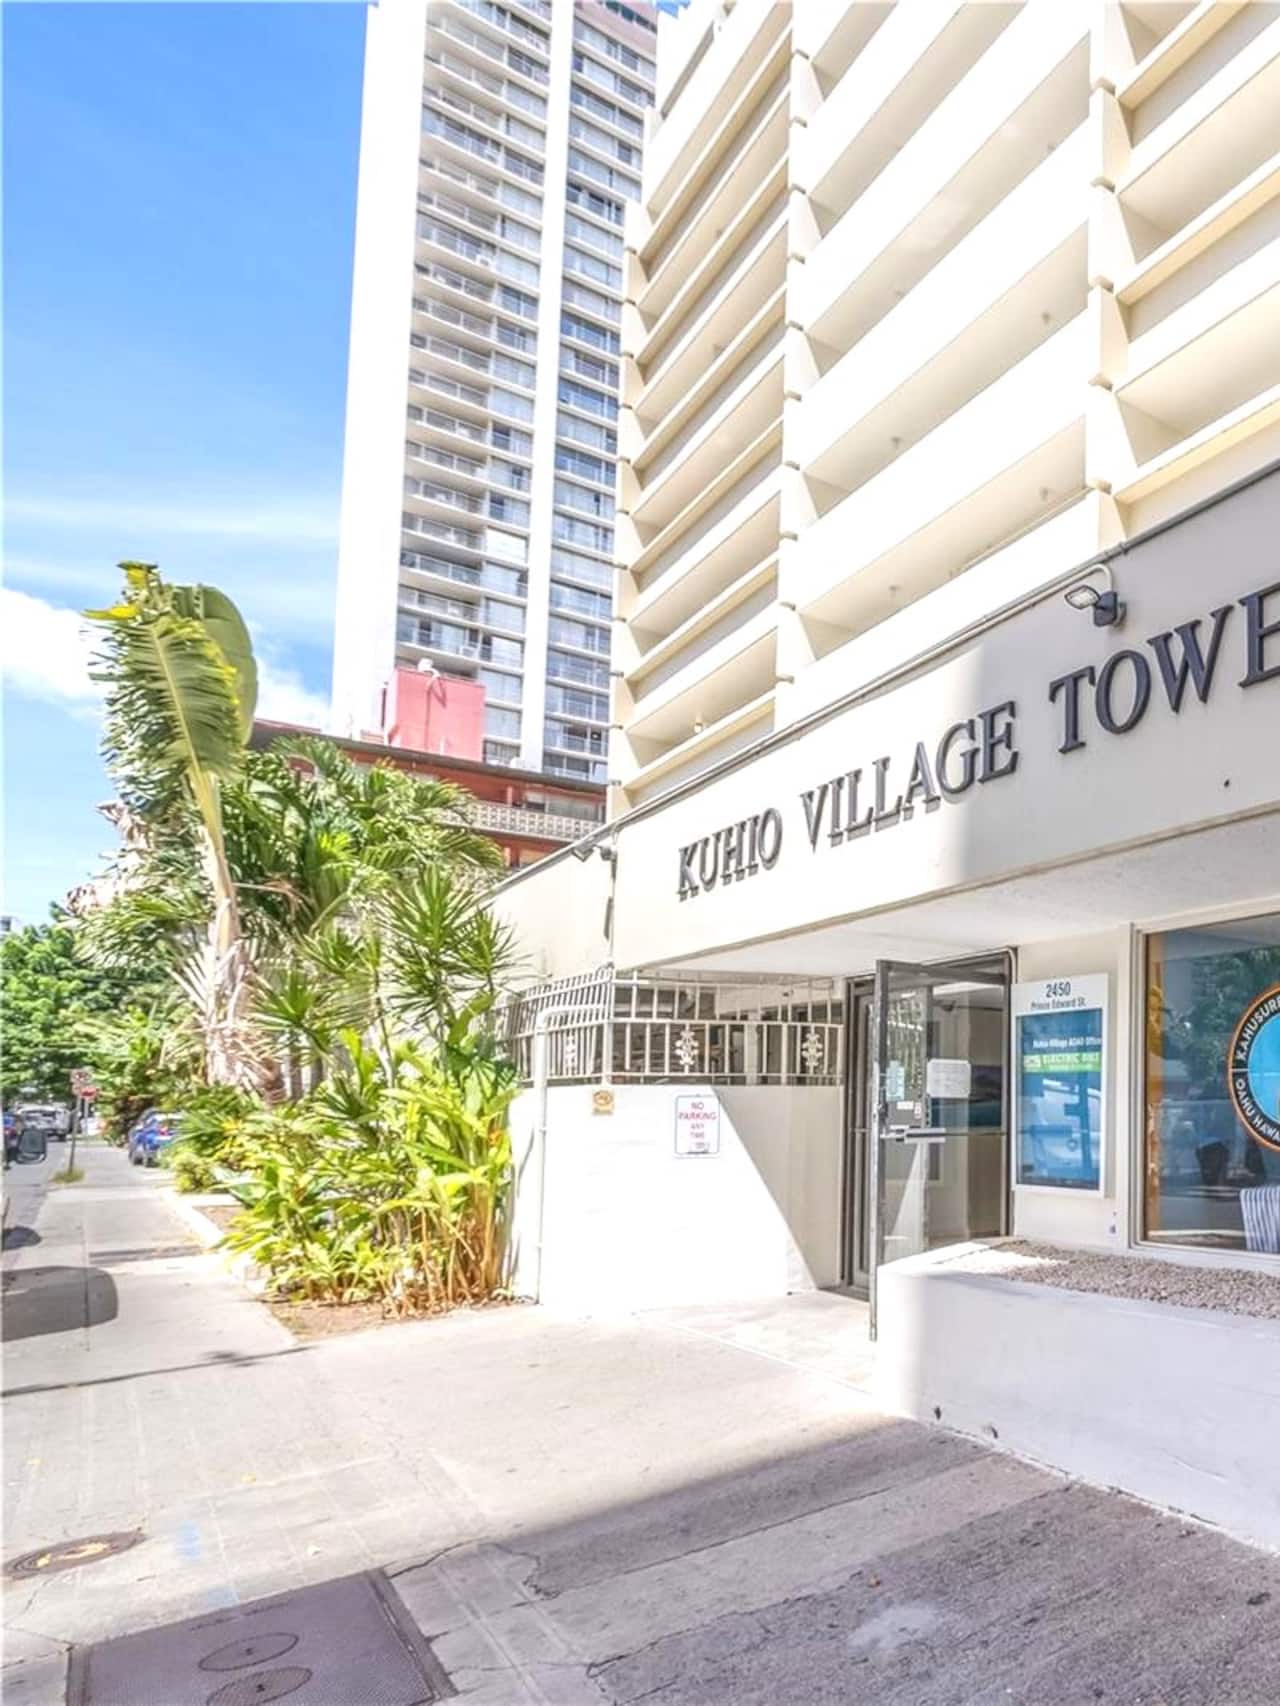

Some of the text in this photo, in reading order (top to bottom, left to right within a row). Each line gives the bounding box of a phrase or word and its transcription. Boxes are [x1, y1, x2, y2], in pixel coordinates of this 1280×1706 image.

[676, 806, 784, 901] KUHIO
[799, 700, 1019, 854] VILLAGE
[1045, 982, 1071, 998] 2450
[1235, 1077, 1256, 1117] OAHU
[690, 1101, 704, 1111] NO
[678, 1111, 717, 1121] PARKING
